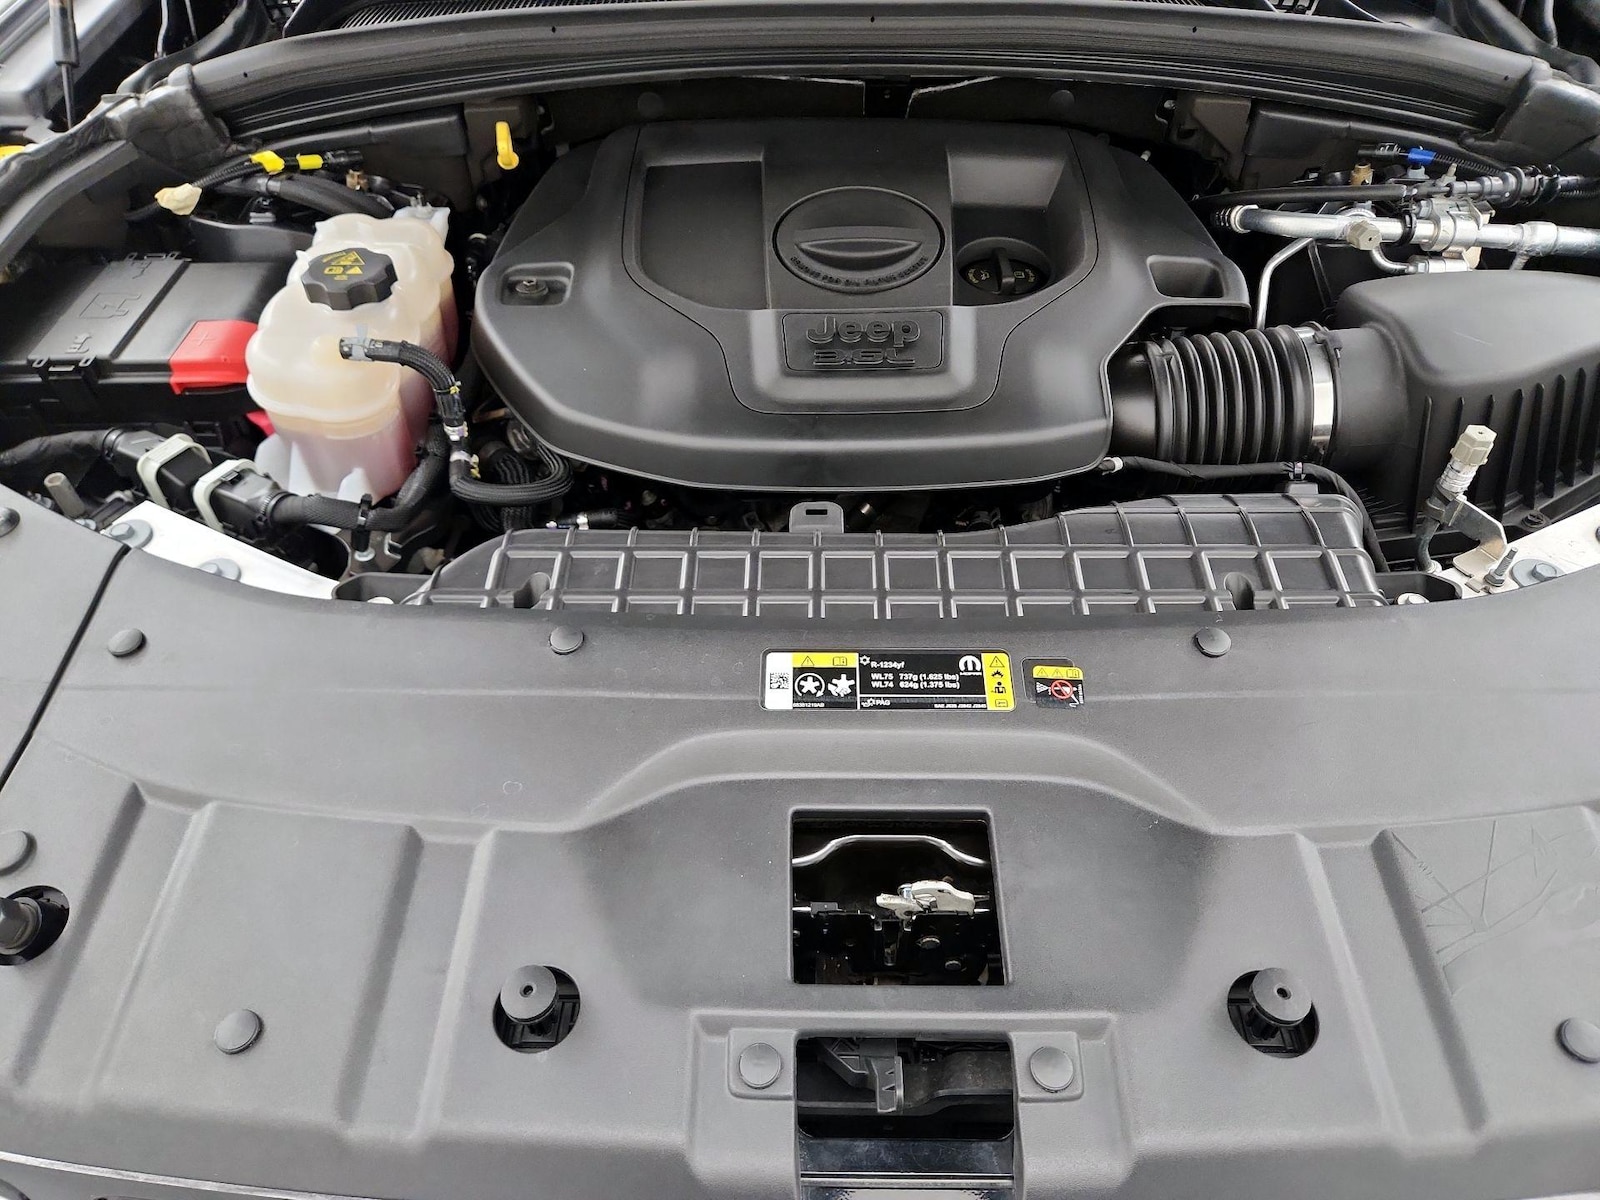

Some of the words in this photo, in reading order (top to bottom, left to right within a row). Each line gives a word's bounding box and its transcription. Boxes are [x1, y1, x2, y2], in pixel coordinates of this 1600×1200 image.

[806, 315, 921, 347] Jeep
[813, 349, 916, 366] 3.6L
[871, 661, 905, 669] R-1234yf
[899, 673, 918, 681] 737g
[919, 673, 943, 681] (1.625
[944, 673, 960, 681] lbs)
[899, 681, 919, 689] 624g
[920, 681, 944, 689] (1.375
[945, 681, 960, 689] lbs)
